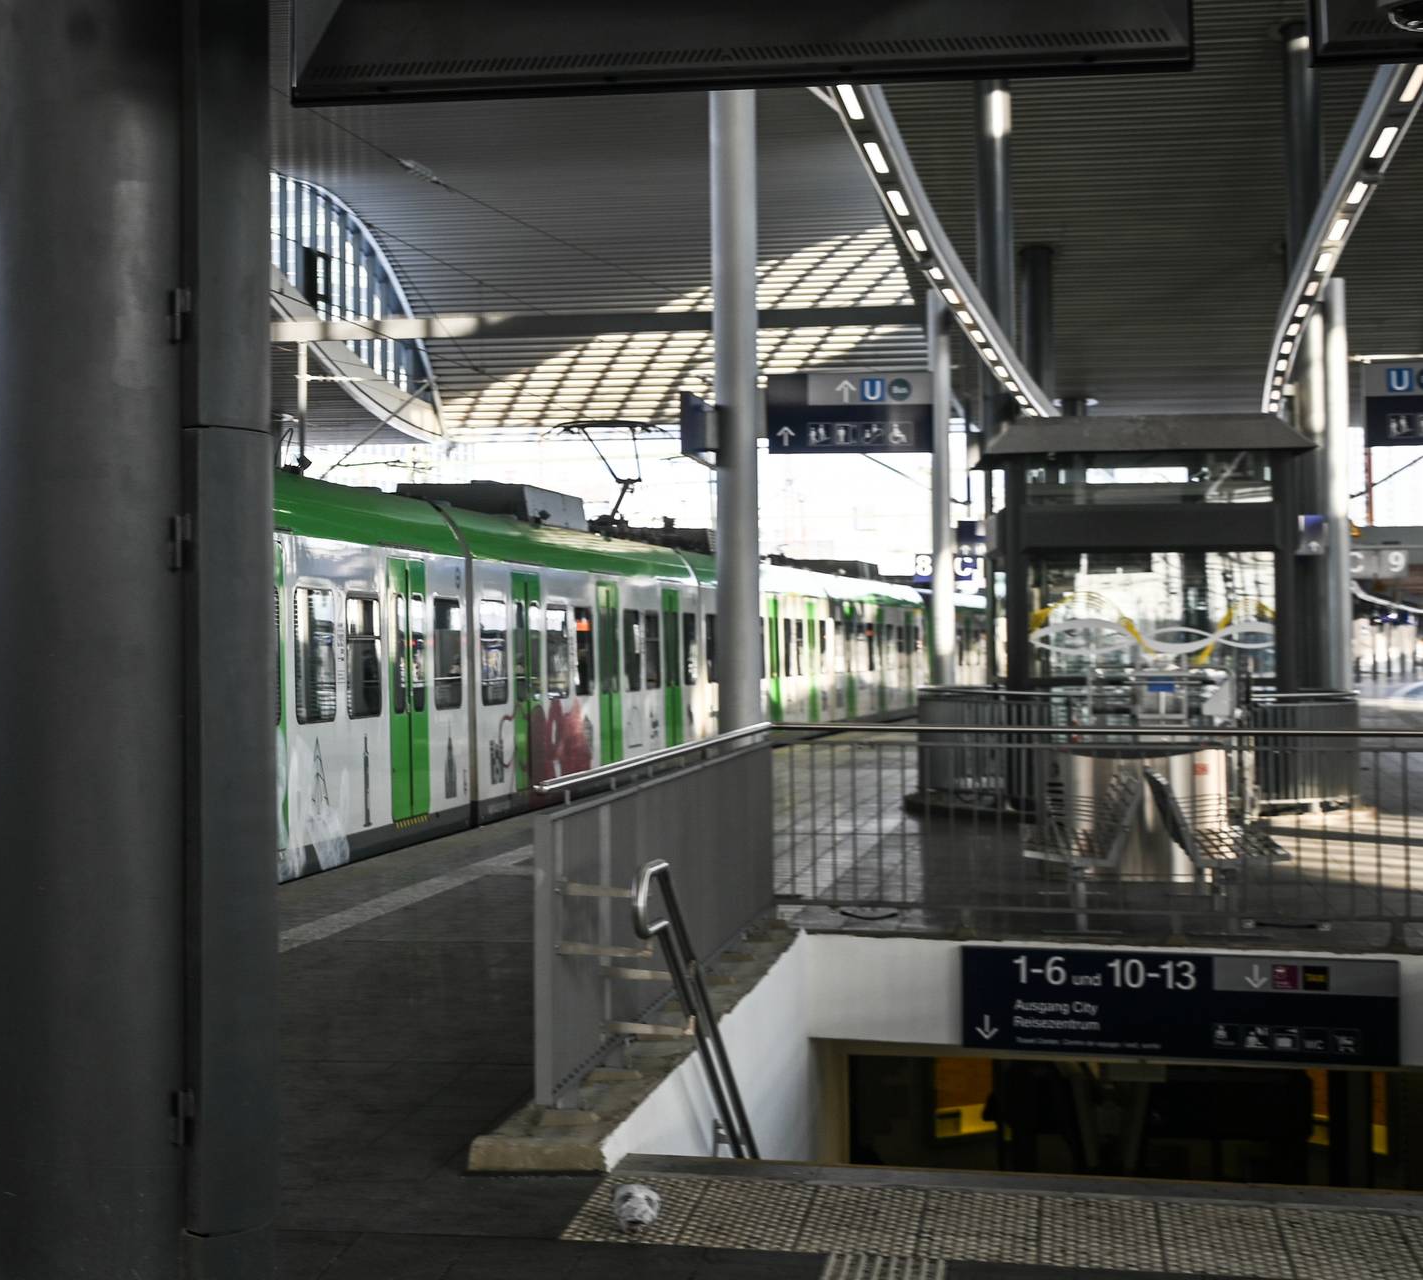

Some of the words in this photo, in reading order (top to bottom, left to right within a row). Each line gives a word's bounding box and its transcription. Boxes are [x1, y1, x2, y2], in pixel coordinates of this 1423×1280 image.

[864, 380, 882, 400] U
[1389, 370, 1410, 391] U
[915, 555, 933, 576] 8
[1388, 551, 1407, 573] 9
[1012, 955, 1068, 986] 1-6
[1071, 973, 1103, 987] und
[1107, 958, 1198, 990] 10-13
[1014, 999, 1071, 1015] Ausgang
[1072, 1001, 1099, 1016] City
[1012, 1015, 1101, 1031] Reisezentrum
